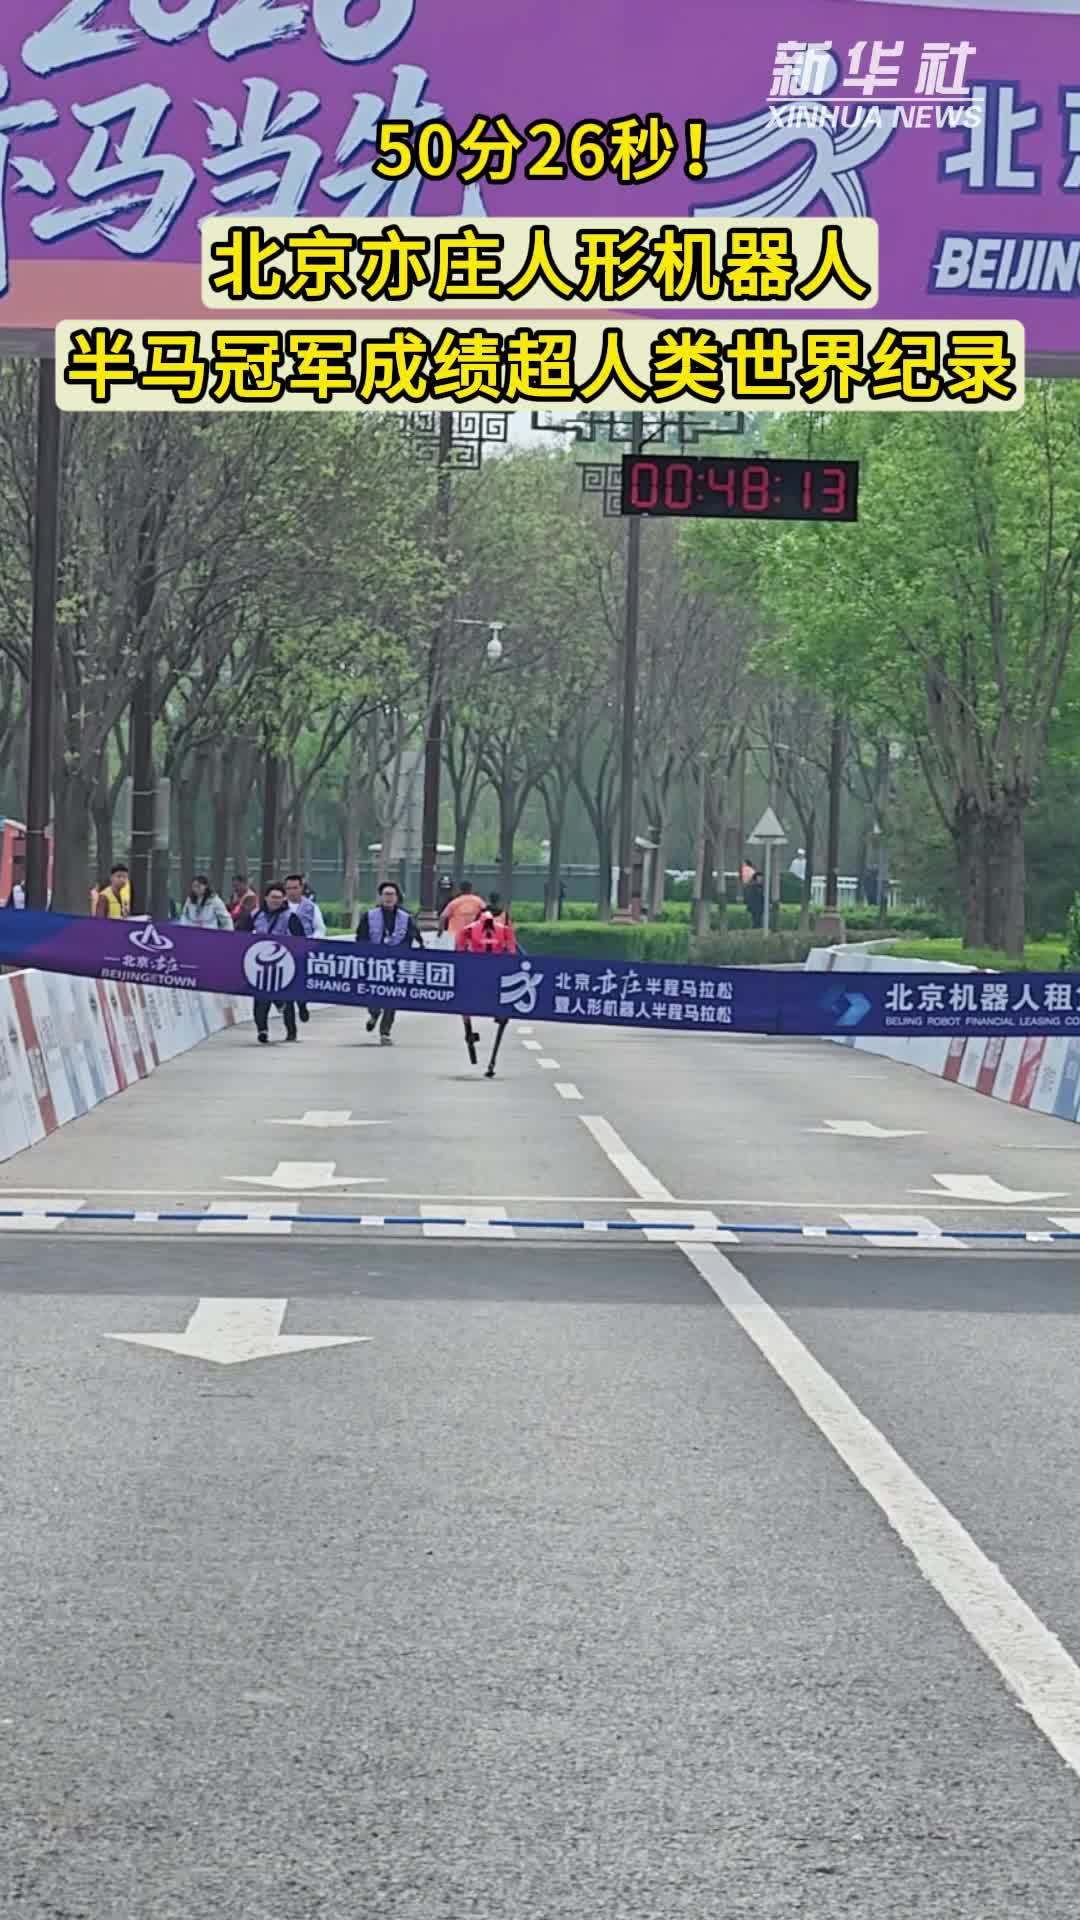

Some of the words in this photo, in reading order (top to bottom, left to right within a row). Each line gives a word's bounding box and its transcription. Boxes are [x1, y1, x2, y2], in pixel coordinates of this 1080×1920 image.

[945, 85, 1080, 188] 北
[933, 237, 1080, 292] BEIJIN
[631, 463, 847, 513] 00:48:13
[307, 952, 455, 987] 尚亦城集团
[555, 968, 733, 1000] 北京亦庄半程马拉松
[306, 978, 351, 992] SHANG
[357, 983, 406, 998] E-TOWN
[410, 987, 455, 1001] GROUP
[885, 983, 1080, 1011] 北京机器人租
[885, 1016, 923, 1026] BEIJING
[927, 1016, 961, 1026] ROBOT
[965, 1016, 1015, 1026] FINANCIAL
[1019, 1015, 1060, 1026] LEASING
